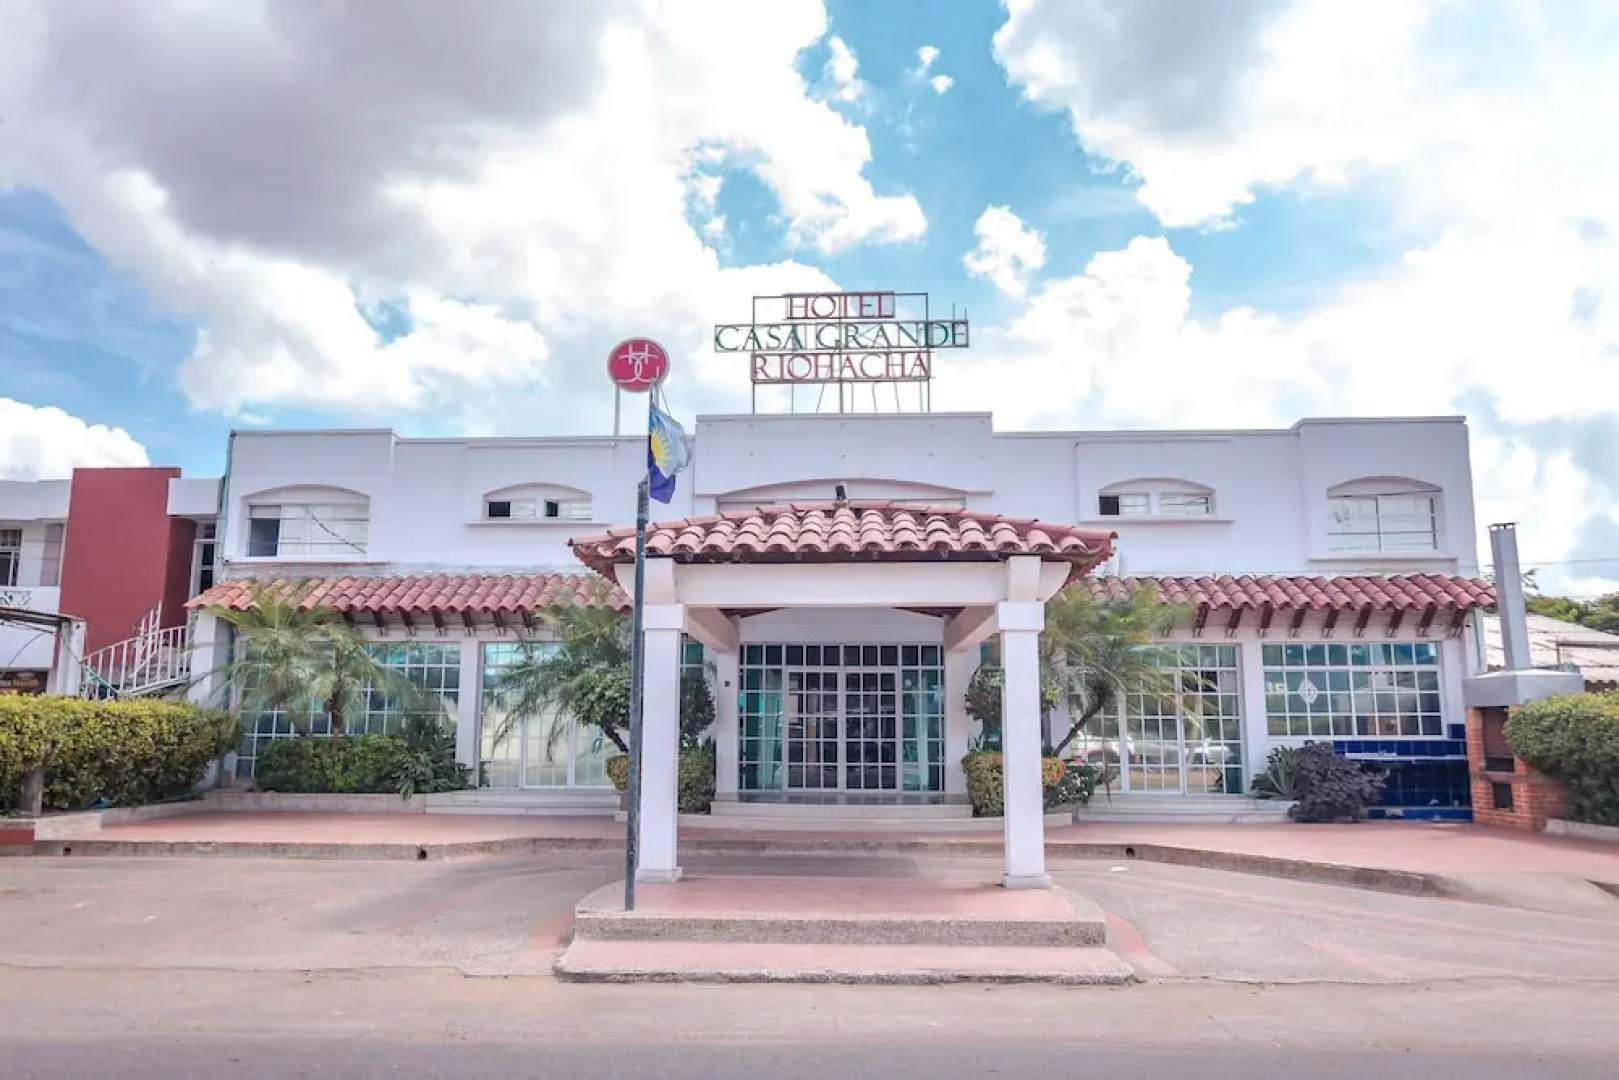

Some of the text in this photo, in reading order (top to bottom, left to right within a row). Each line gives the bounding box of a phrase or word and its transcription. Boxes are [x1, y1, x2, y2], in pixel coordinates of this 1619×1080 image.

[788, 293, 895, 319] HOTEL
[715, 319, 969, 352] CASA GRANDE
[751, 351, 931, 381] RIOHACHA
